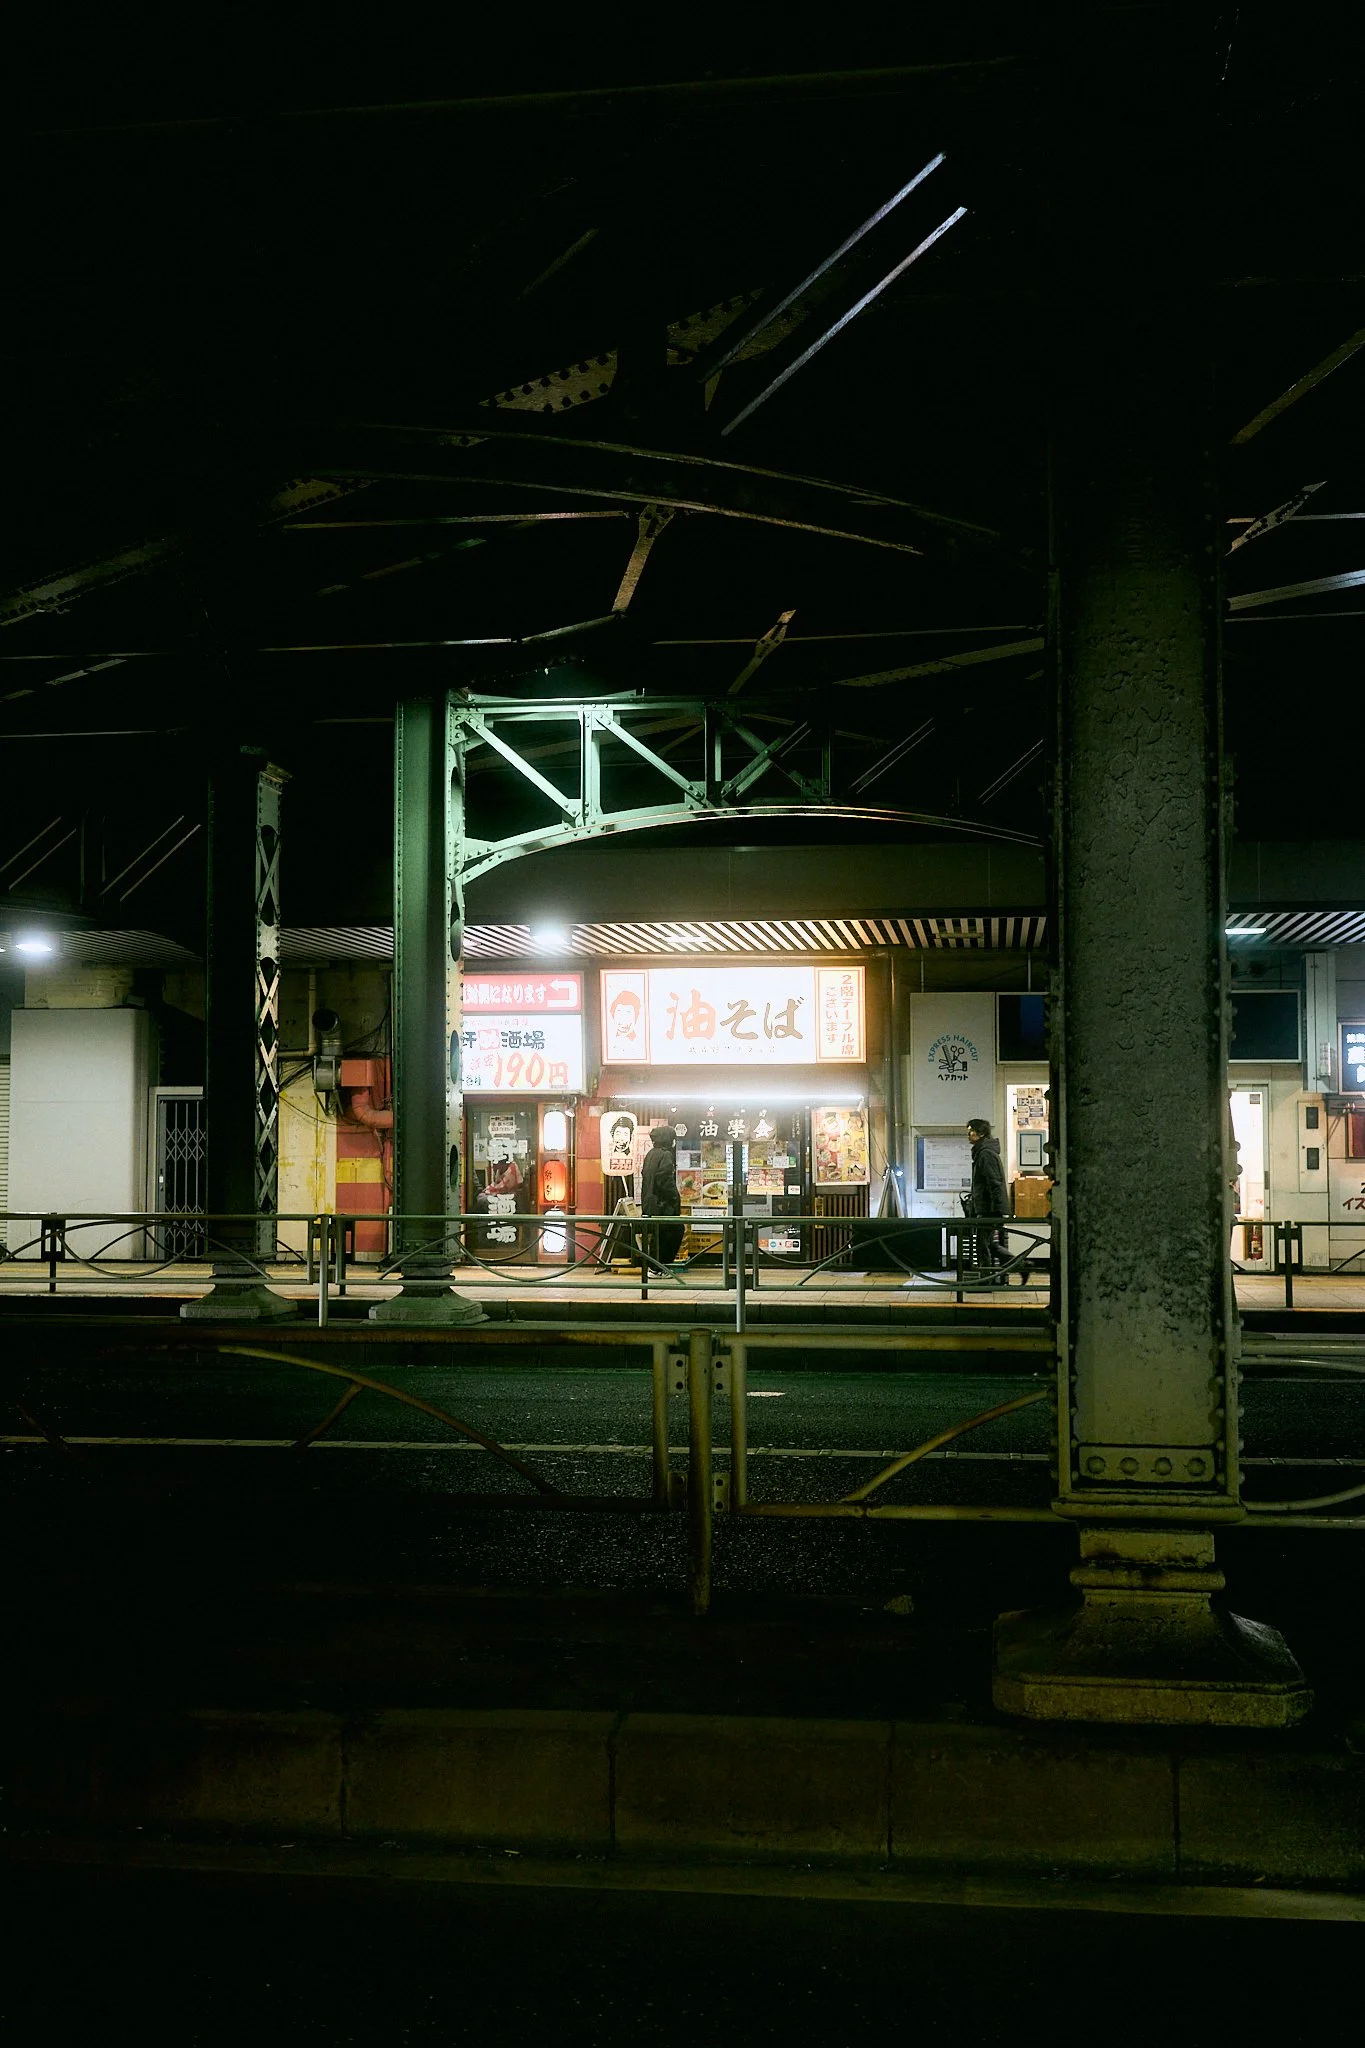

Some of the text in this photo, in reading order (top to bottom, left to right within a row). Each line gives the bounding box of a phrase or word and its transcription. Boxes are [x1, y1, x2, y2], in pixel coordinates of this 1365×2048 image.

[665, 988, 805, 1042] 油そば
[928, 1034, 979, 1063] EXPRESS HAIRCUT
[937, 1073, 969, 1081] ヘアカット
